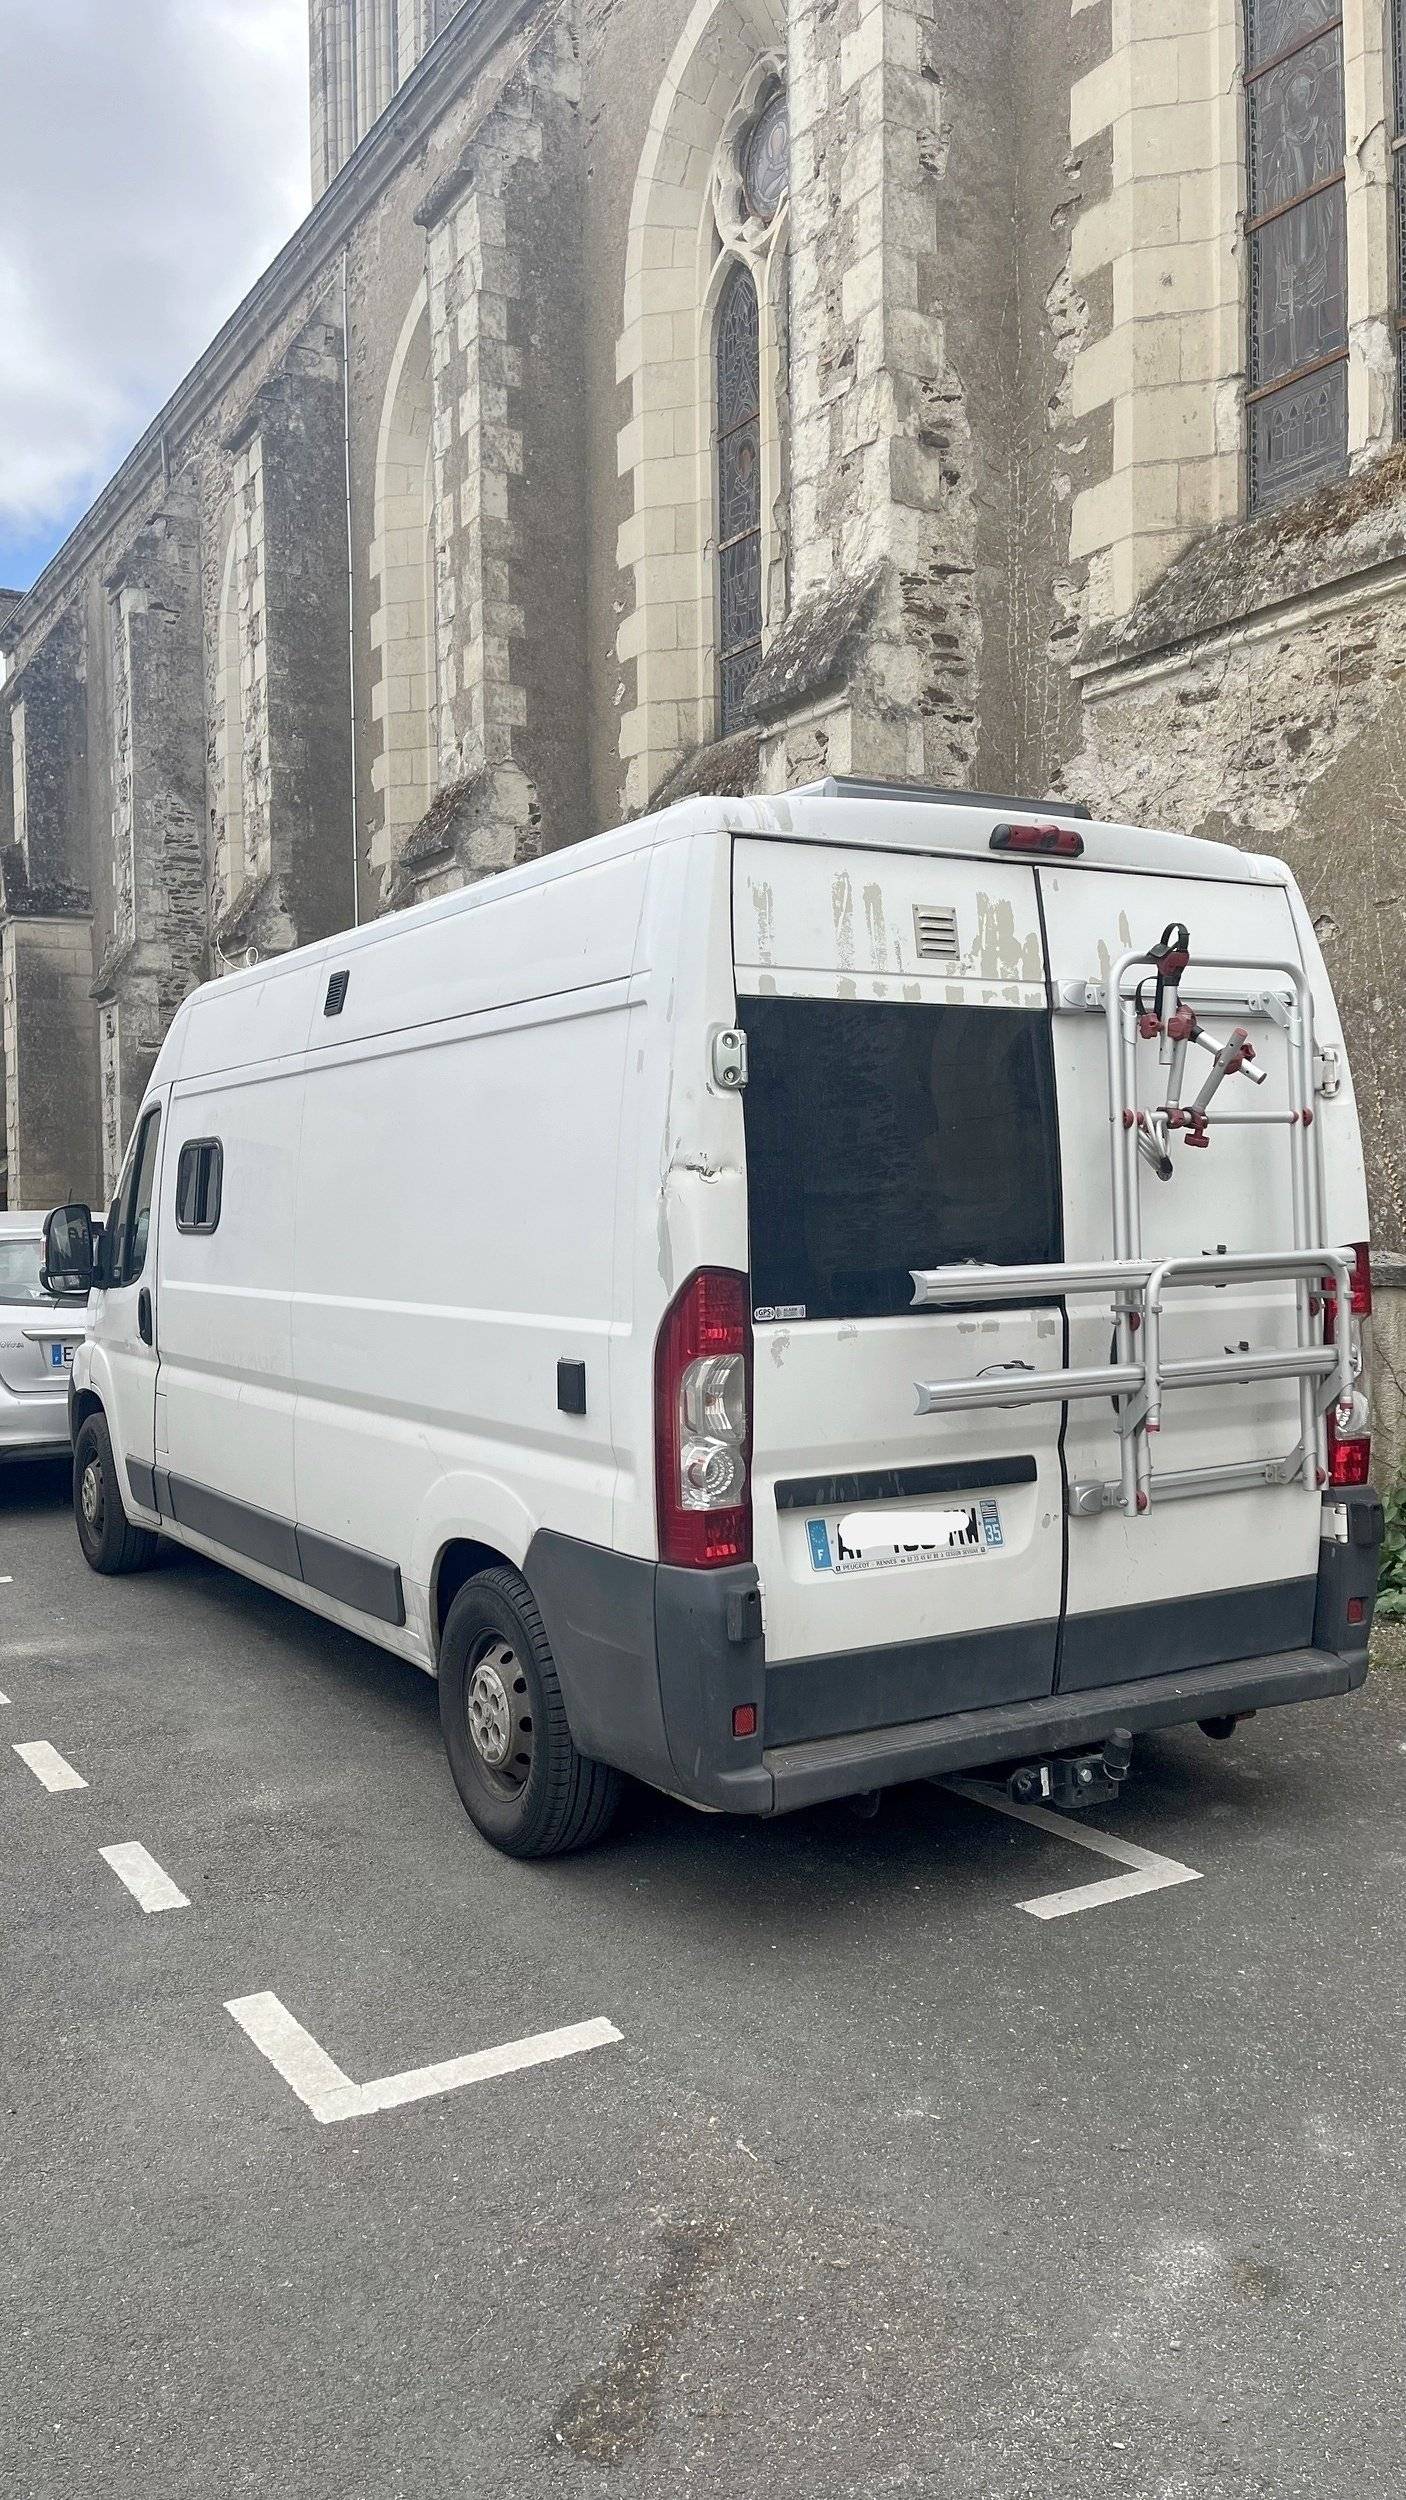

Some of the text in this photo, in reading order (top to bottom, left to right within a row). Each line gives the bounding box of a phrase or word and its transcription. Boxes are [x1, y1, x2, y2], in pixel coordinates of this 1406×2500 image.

[985, 1523, 1002, 1542] 35
[818, 1549, 824, 1561] F
[842, 1562, 870, 1571] PEUGEOT
